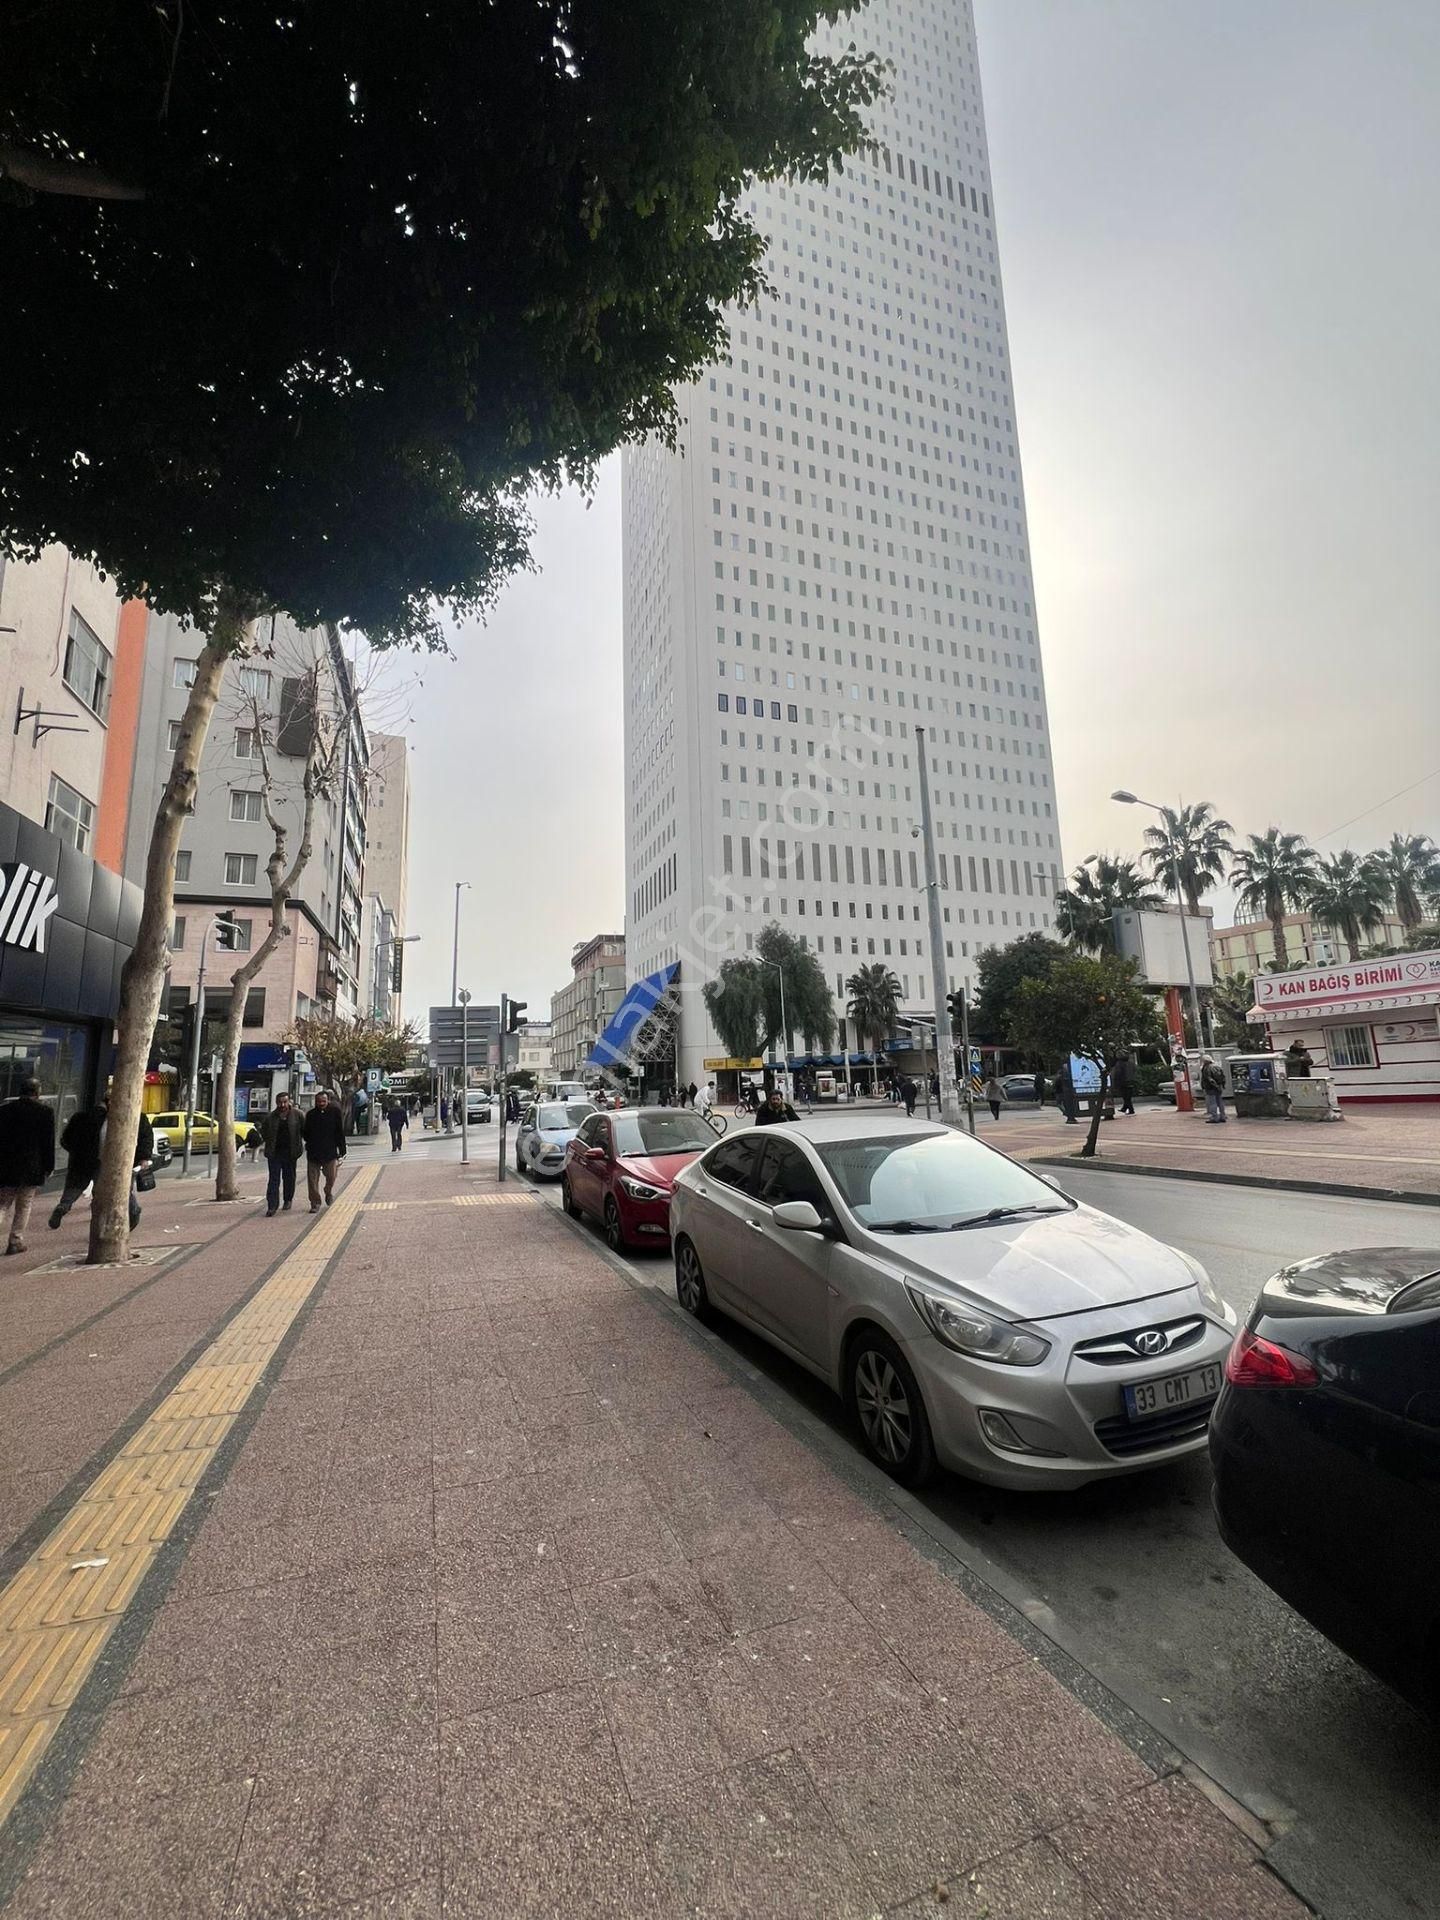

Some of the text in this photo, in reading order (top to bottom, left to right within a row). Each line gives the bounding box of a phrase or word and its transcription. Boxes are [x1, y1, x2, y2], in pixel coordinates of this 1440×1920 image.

[0, 863, 59, 954] lik
[1278, 964, 1403, 996] KAN BAĞIŞ BİRİMİ
[370, 1072, 377, 1080] D
[1136, 1385, 1156, 1411] 33
[1200, 1368, 1217, 1393] 13
